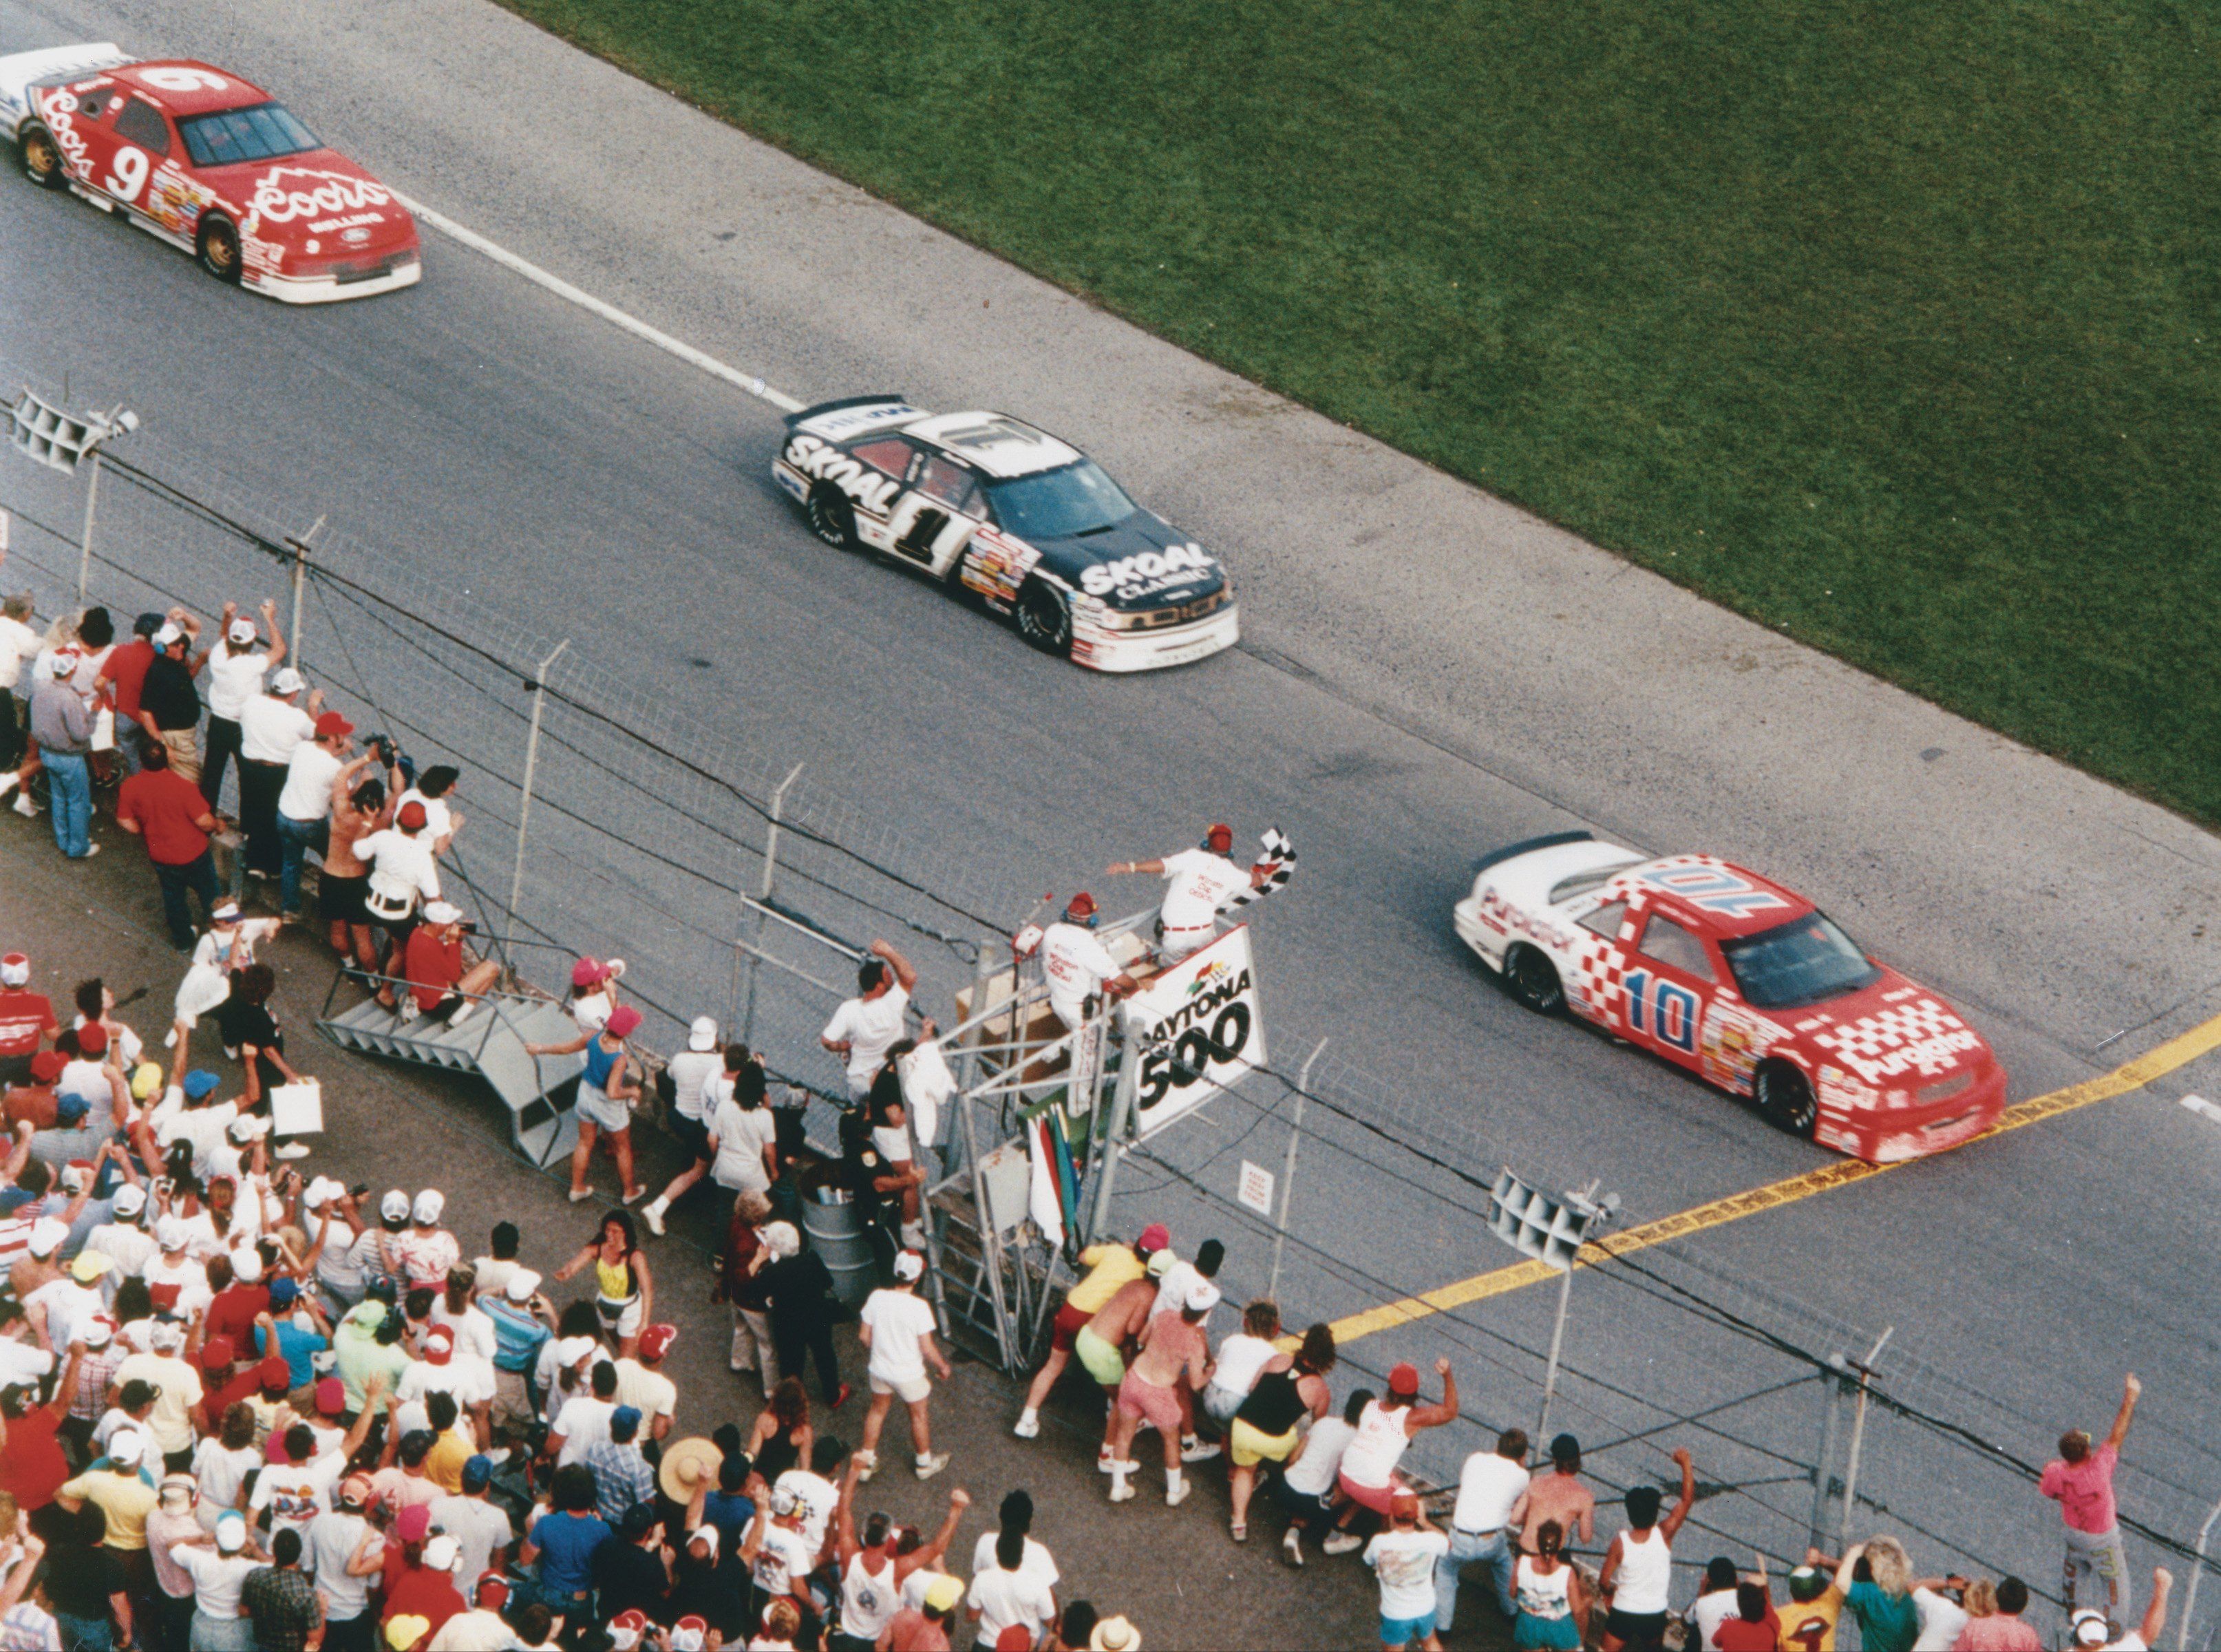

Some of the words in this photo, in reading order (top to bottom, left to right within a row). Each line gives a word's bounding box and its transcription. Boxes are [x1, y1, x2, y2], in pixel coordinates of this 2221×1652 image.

[43, 90, 96, 180] Coors
[105, 146, 149, 202] 9
[254, 180, 390, 222] Coors
[786, 435, 900, 514] SKOAL
[894, 507, 952, 567] 1
[1080, 542, 1215, 595] SKOAL
[1639, 865, 1791, 919] 10
[1619, 966, 1702, 1057] 10
[1139, 1002, 1251, 1110] 500
